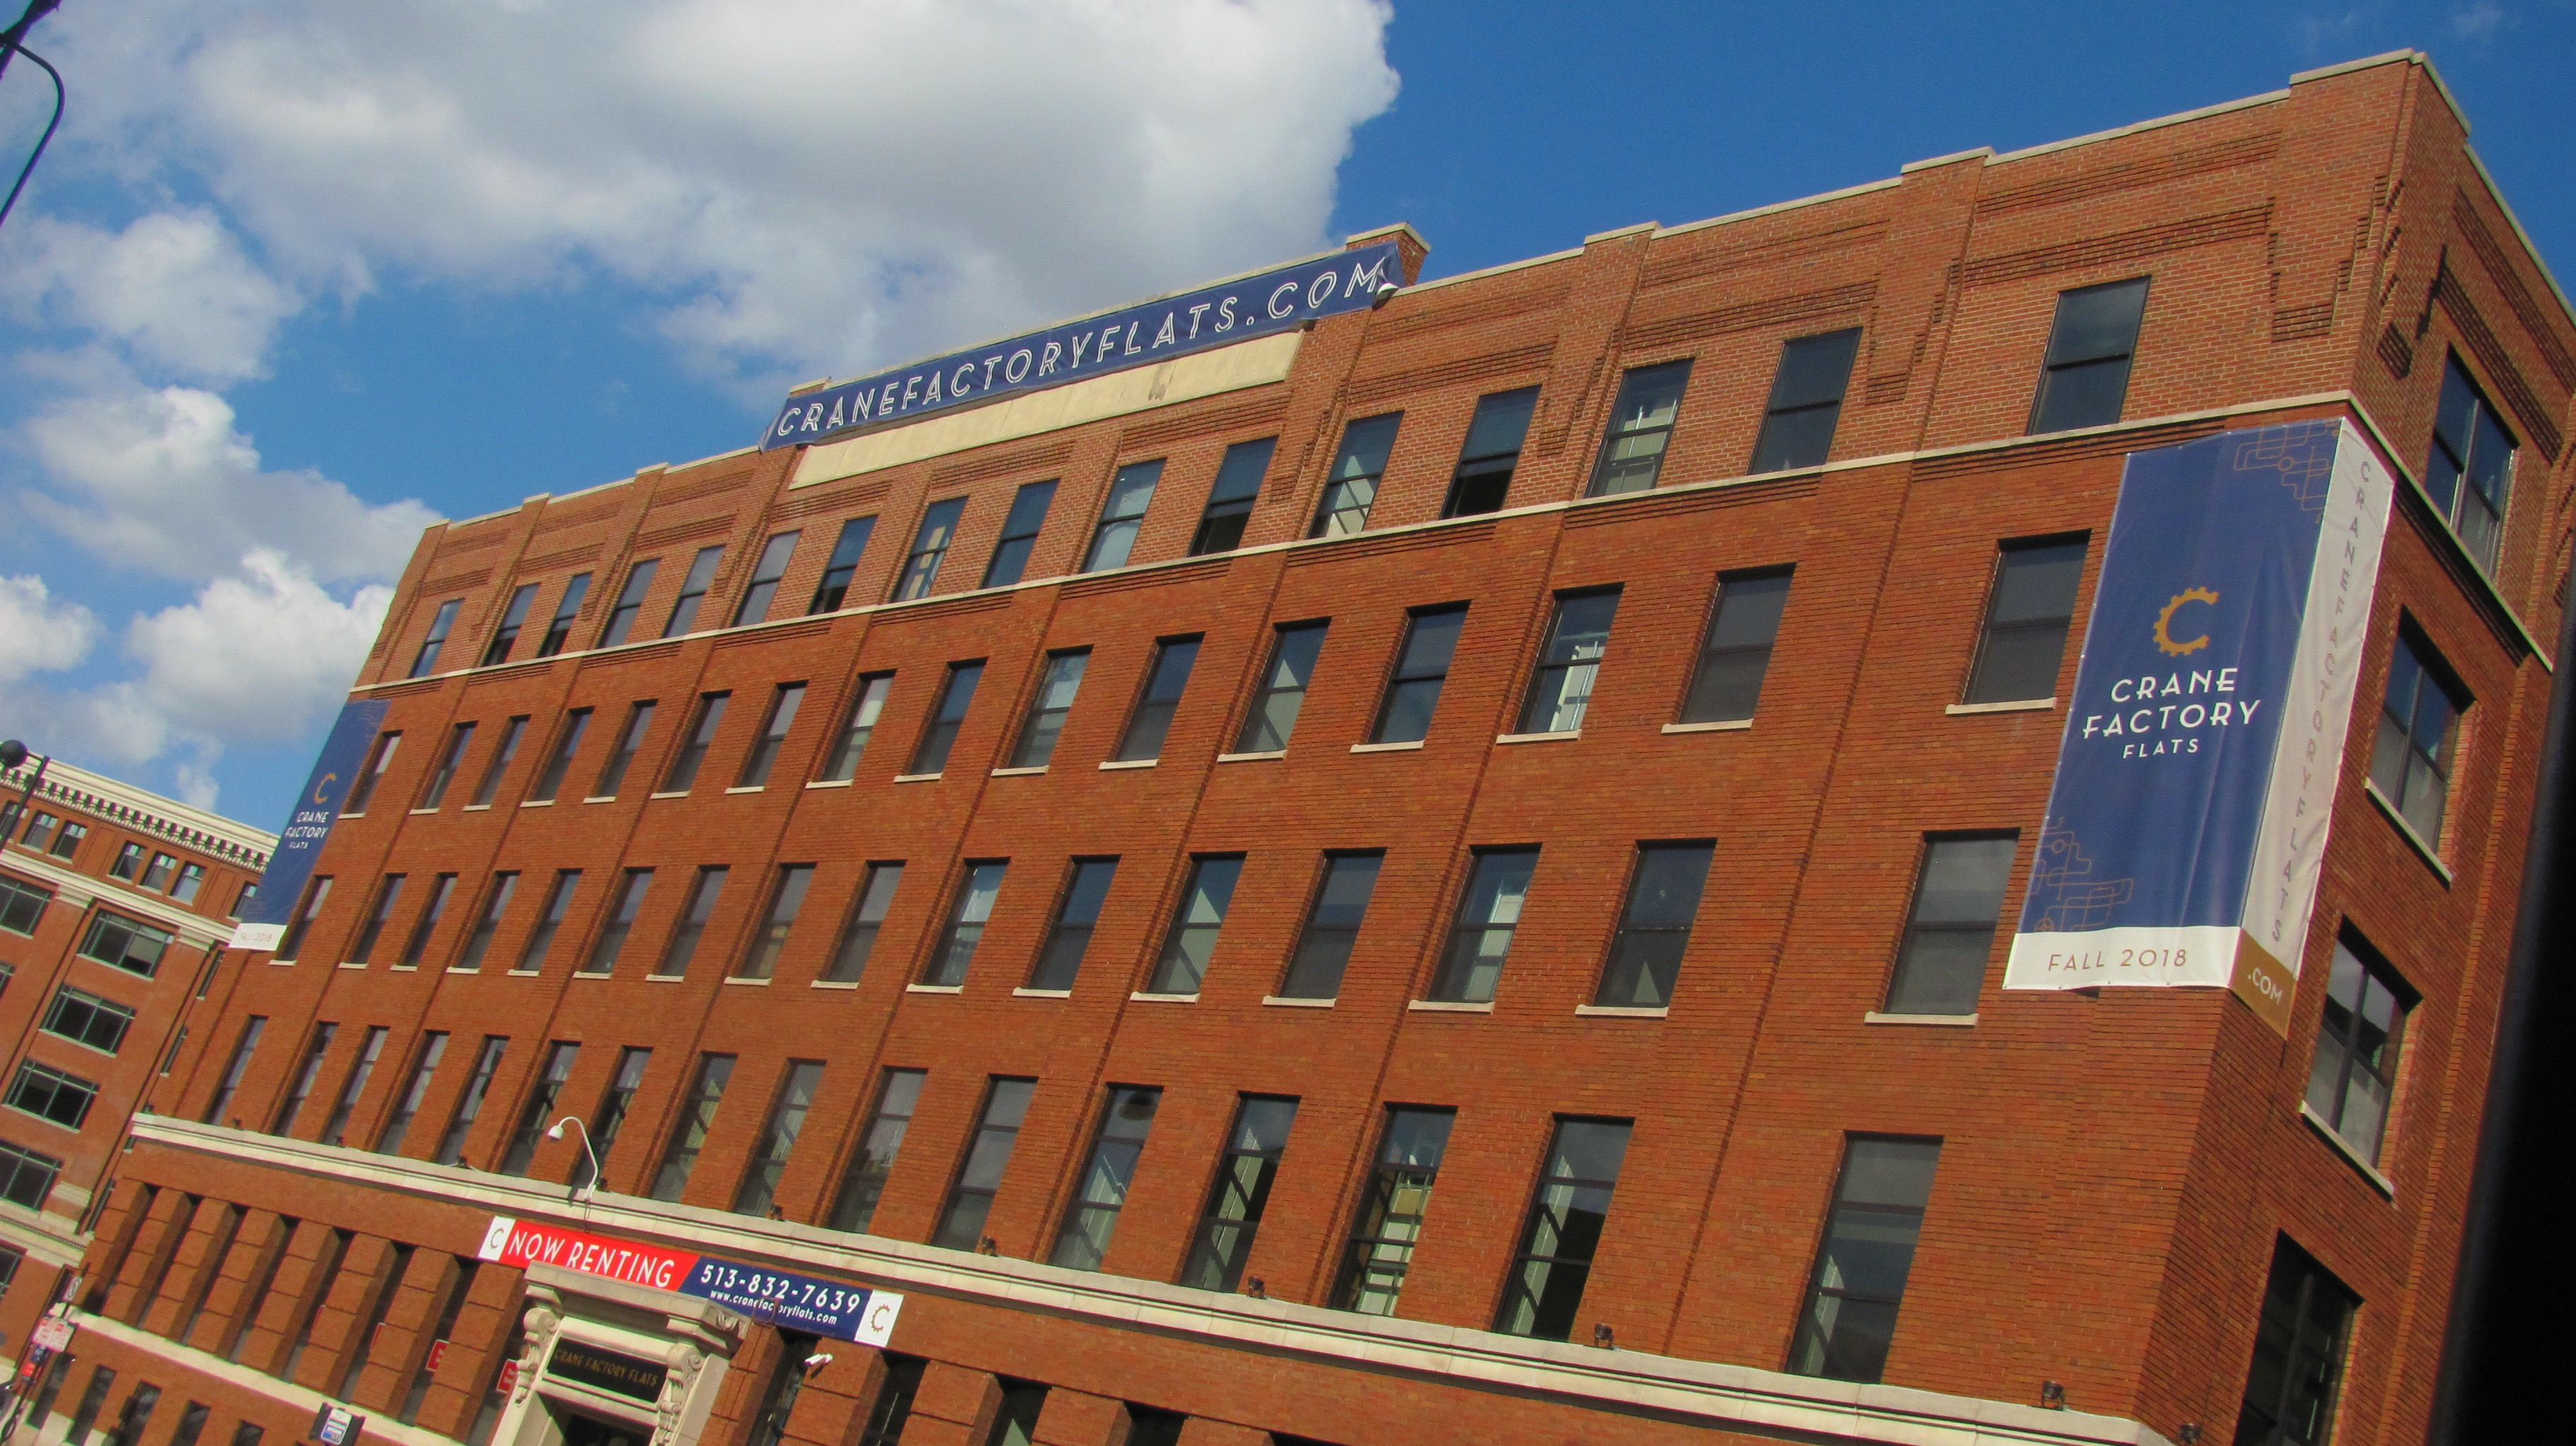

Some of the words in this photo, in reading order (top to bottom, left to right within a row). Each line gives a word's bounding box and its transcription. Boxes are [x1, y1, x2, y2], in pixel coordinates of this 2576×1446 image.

[777, 256, 1385, 436] CRANEFACTORYFLATS.COM
[2111, 668, 2238, 703] CRANE
[2082, 699, 2261, 739] FACTORY
[2123, 739, 2199, 759] FLATS
[285, 826, 330, 838] FACTORY
[297, 811, 330, 823] CRANE
[2048, 951, 2105, 972] FALL
[2119, 949, 2187, 967] 2018
[508, 1230, 566, 1264] NOW
[566, 1241, 674, 1288] RENTING
[700, 1264, 861, 1314] 513-832-7639
[710, 1289, 838, 1325] www.cranefacoryflats.com
[554, 1349, 585, 1367] CRANE
[585, 1356, 626, 1378] FACTORY
[628, 1369, 658, 1387] FLATS
